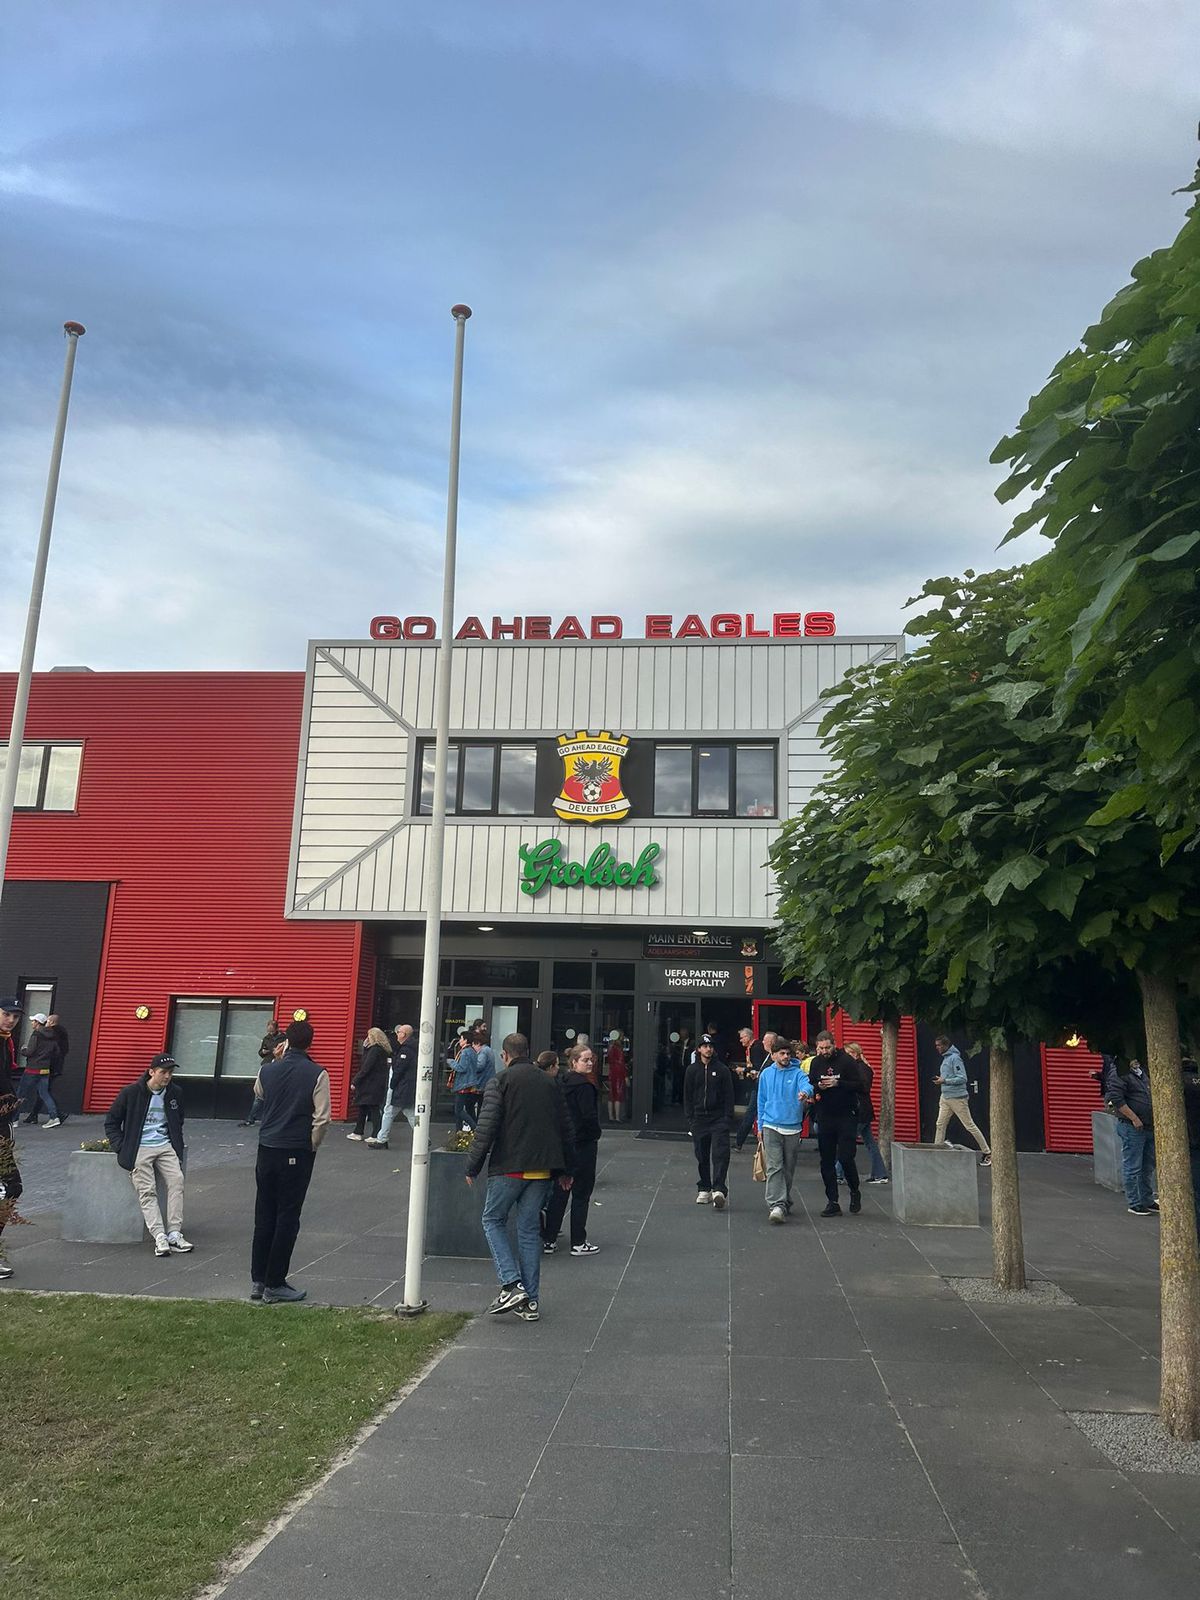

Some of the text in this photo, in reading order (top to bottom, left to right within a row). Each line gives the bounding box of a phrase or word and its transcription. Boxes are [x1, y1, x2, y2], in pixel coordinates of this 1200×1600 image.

[369, 611, 836, 641] GO AHEAD EAGLES
[559, 743, 626, 755] GO AHEAD EAGLES
[568, 803, 617, 813] DEVENTER
[519, 838, 660, 895] Grolsch
[648, 934, 732, 945] MAIN ENTRANCE
[664, 969, 730, 978] UEFA PARTNER
[668, 979, 726, 987] HOSPITALITY
